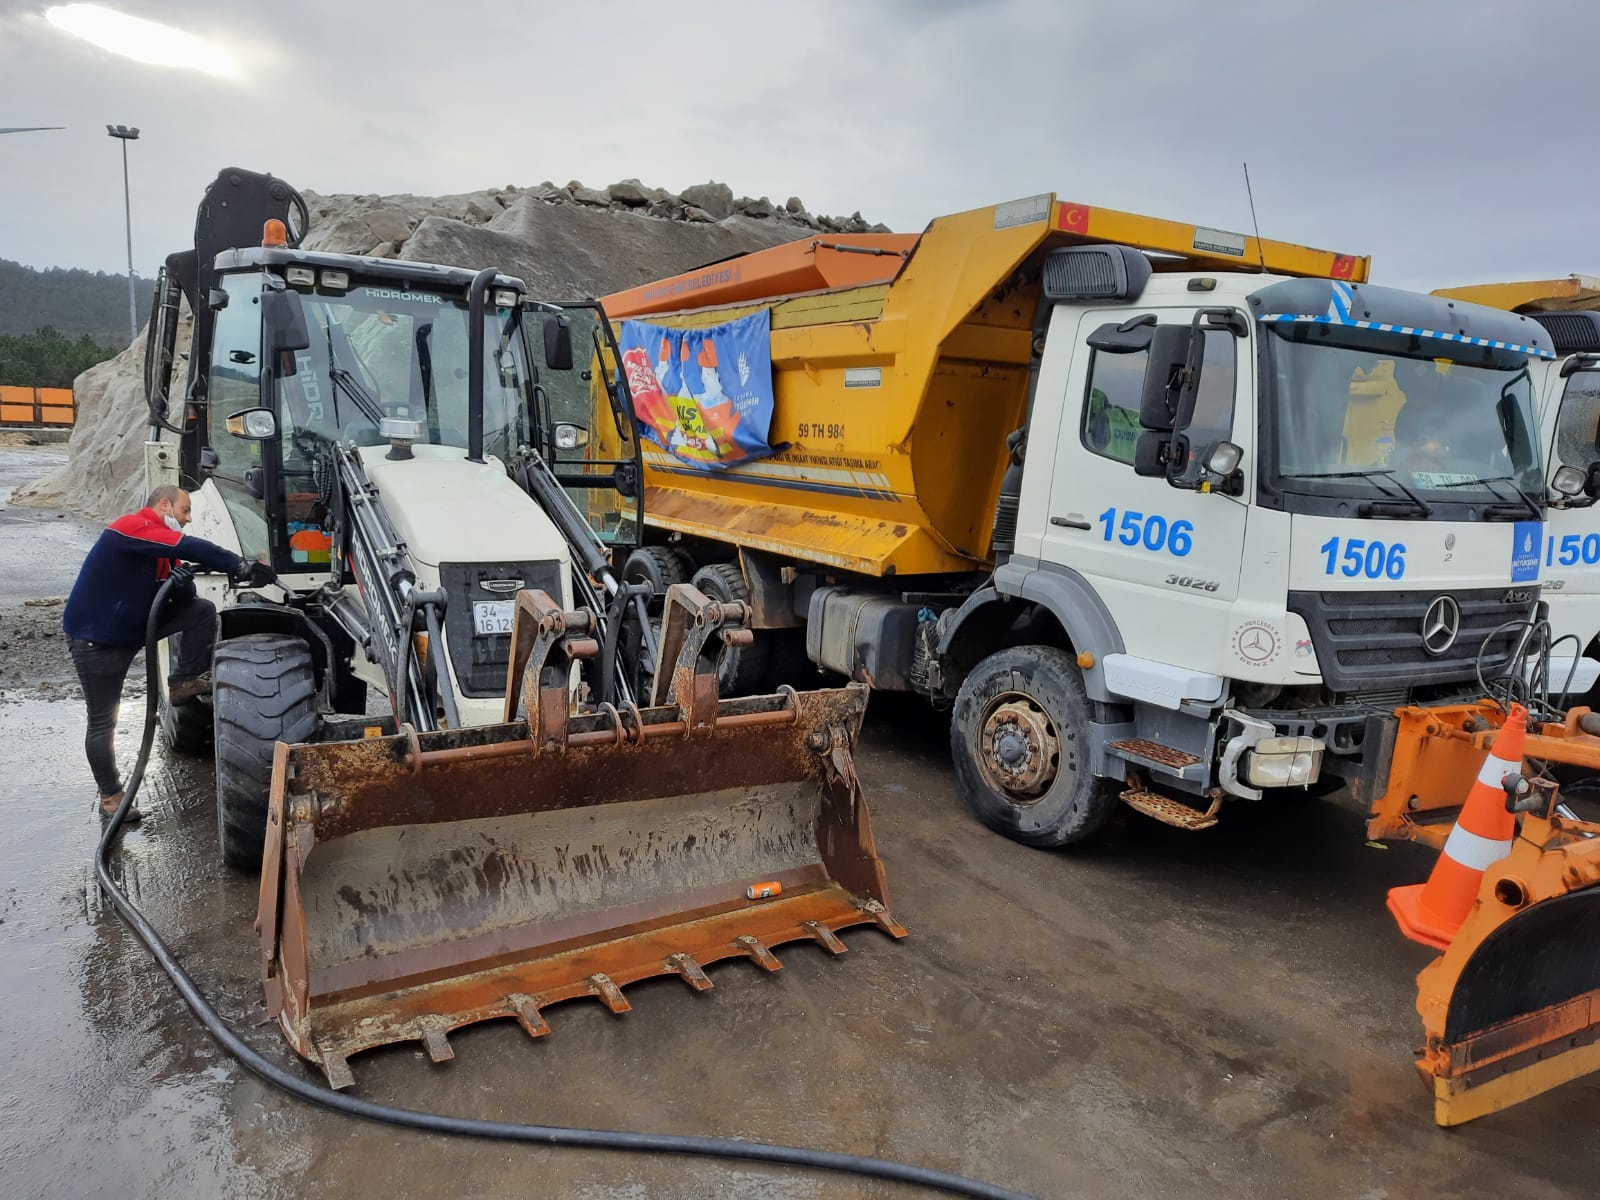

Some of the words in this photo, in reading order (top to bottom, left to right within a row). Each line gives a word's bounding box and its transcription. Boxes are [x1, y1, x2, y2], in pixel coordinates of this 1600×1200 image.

[798, 423, 809, 438] 59
[812, 424, 825, 439] TH
[1099, 507, 1193, 557] 1506
[1320, 536, 1406, 581] 1506
[480, 605, 497, 618] 34
[480, 619, 494, 632] 16
